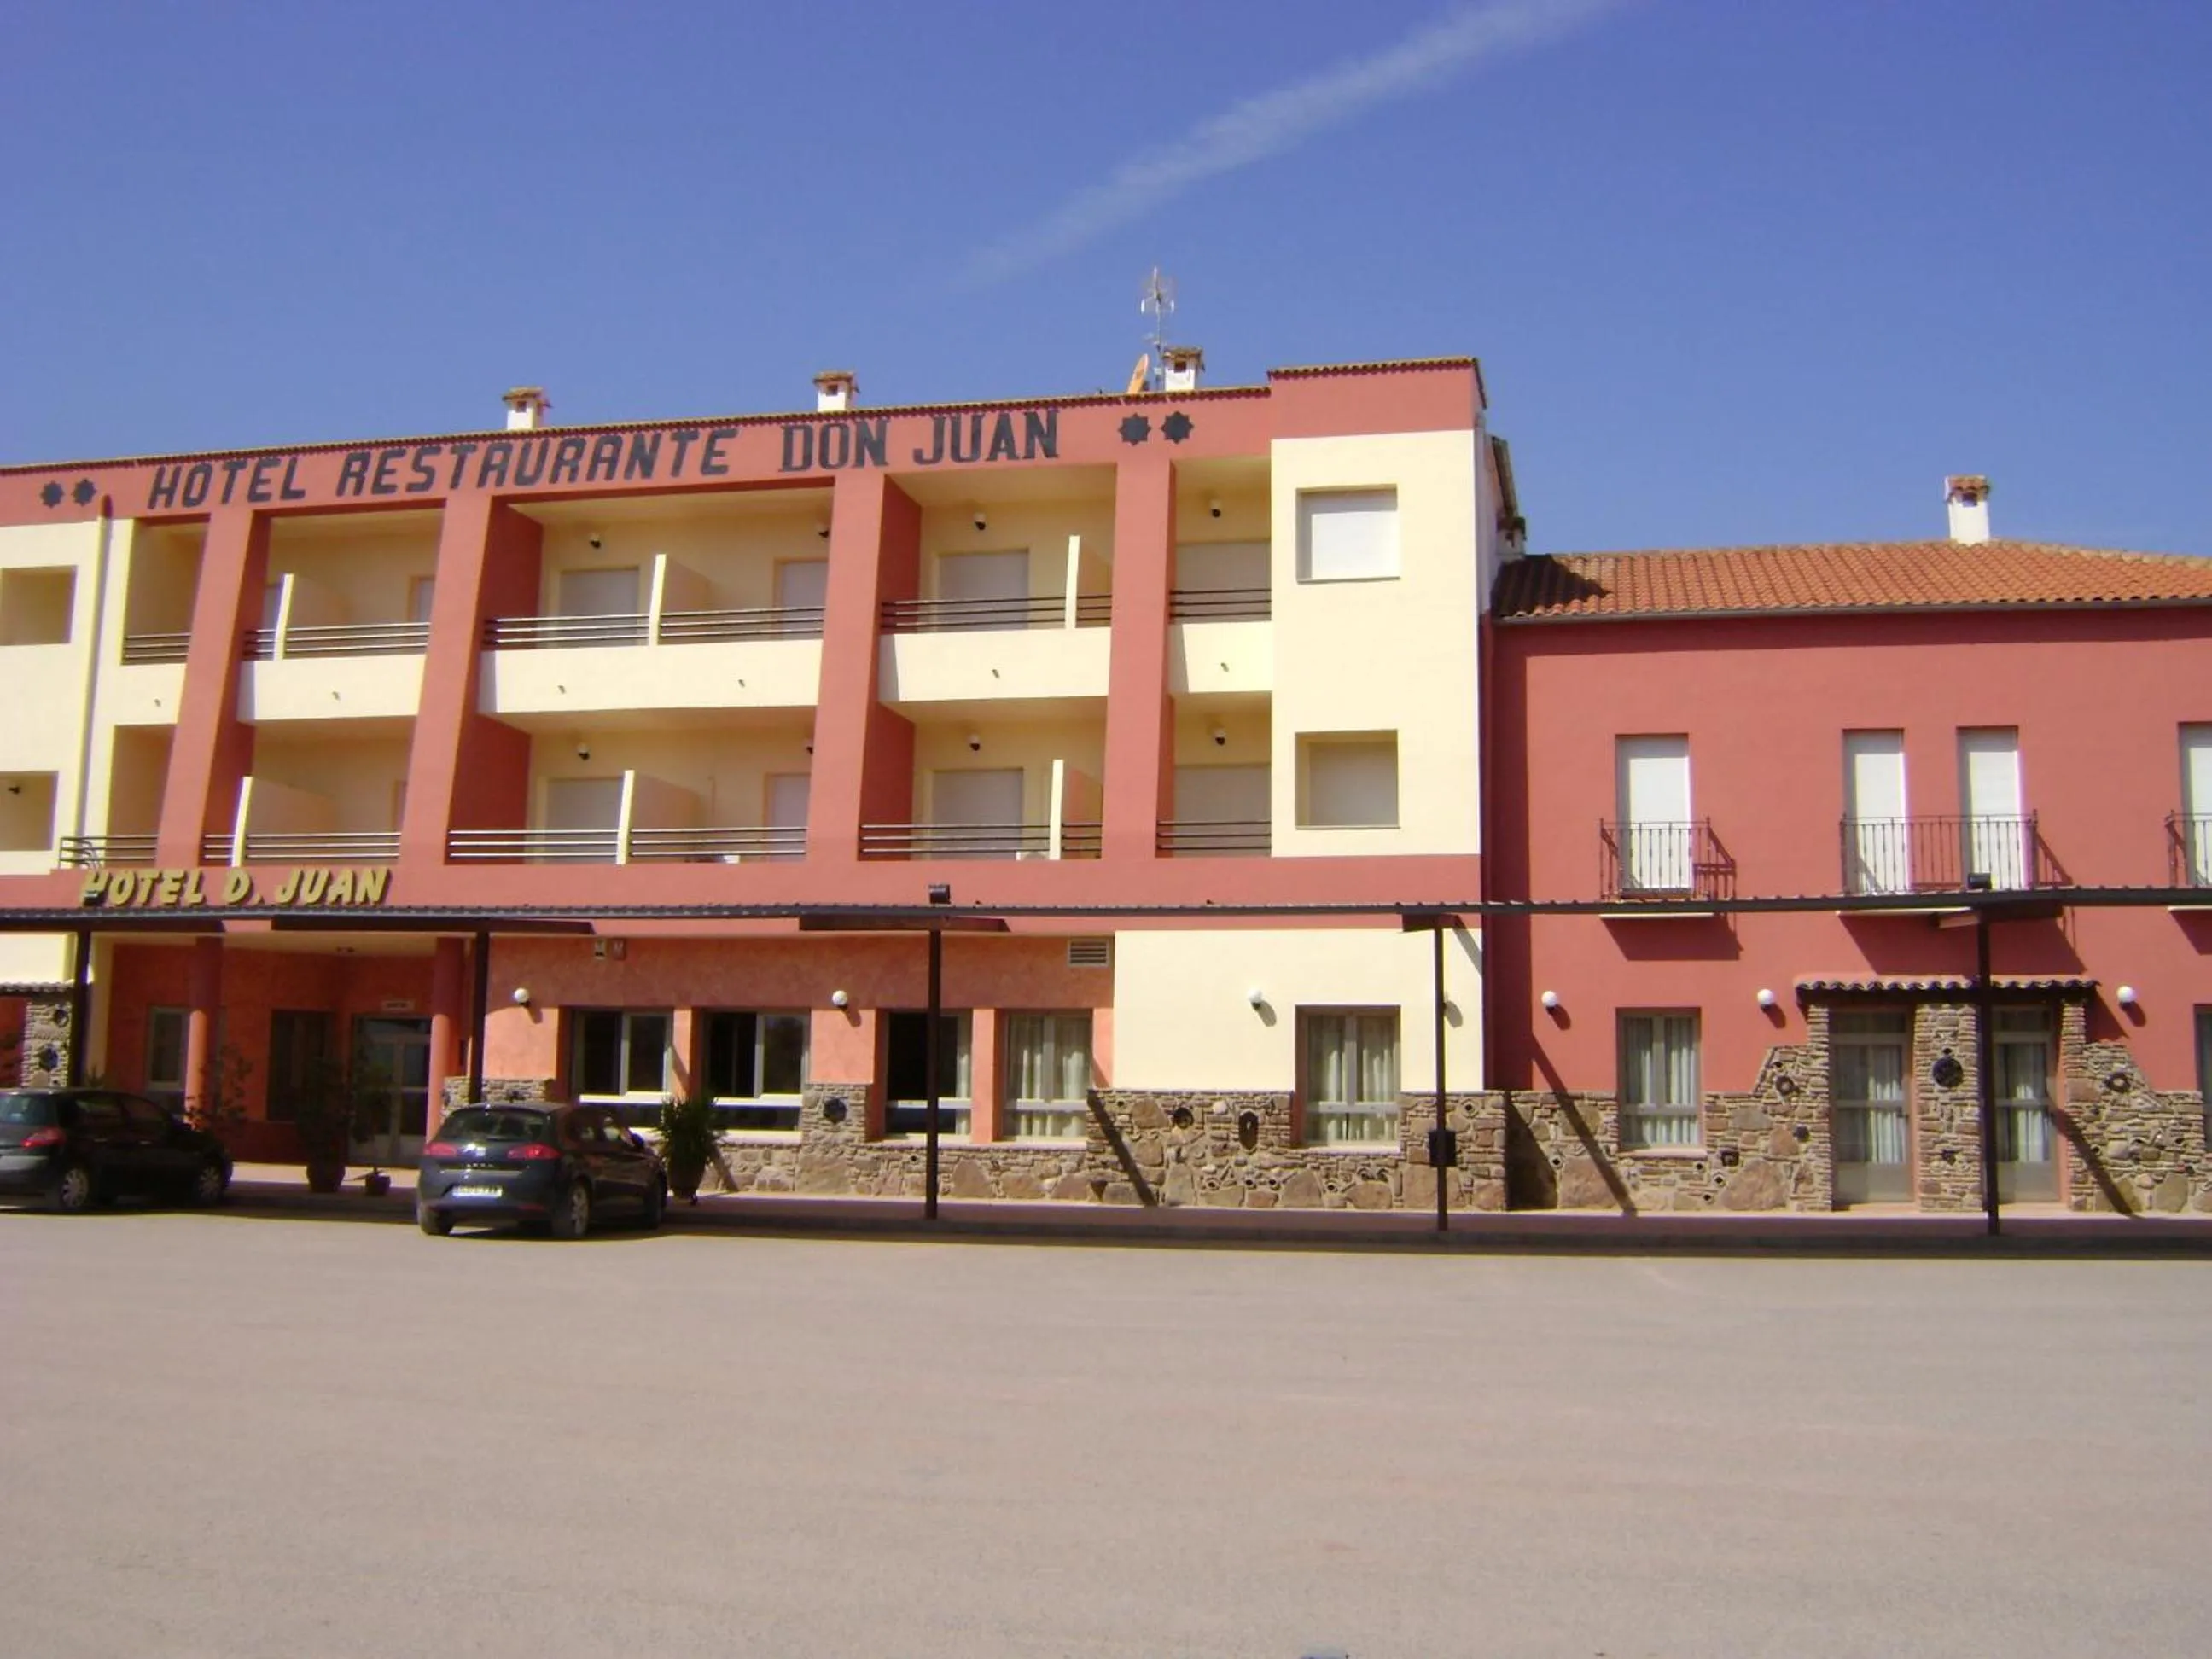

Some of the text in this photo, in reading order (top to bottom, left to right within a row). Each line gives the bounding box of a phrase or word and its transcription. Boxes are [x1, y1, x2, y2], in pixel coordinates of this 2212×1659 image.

[148, 410, 1059, 509] HOTEL RESTAURANTE DON JUAN
[79, 867, 390, 906] HOTEL D. JUAN
